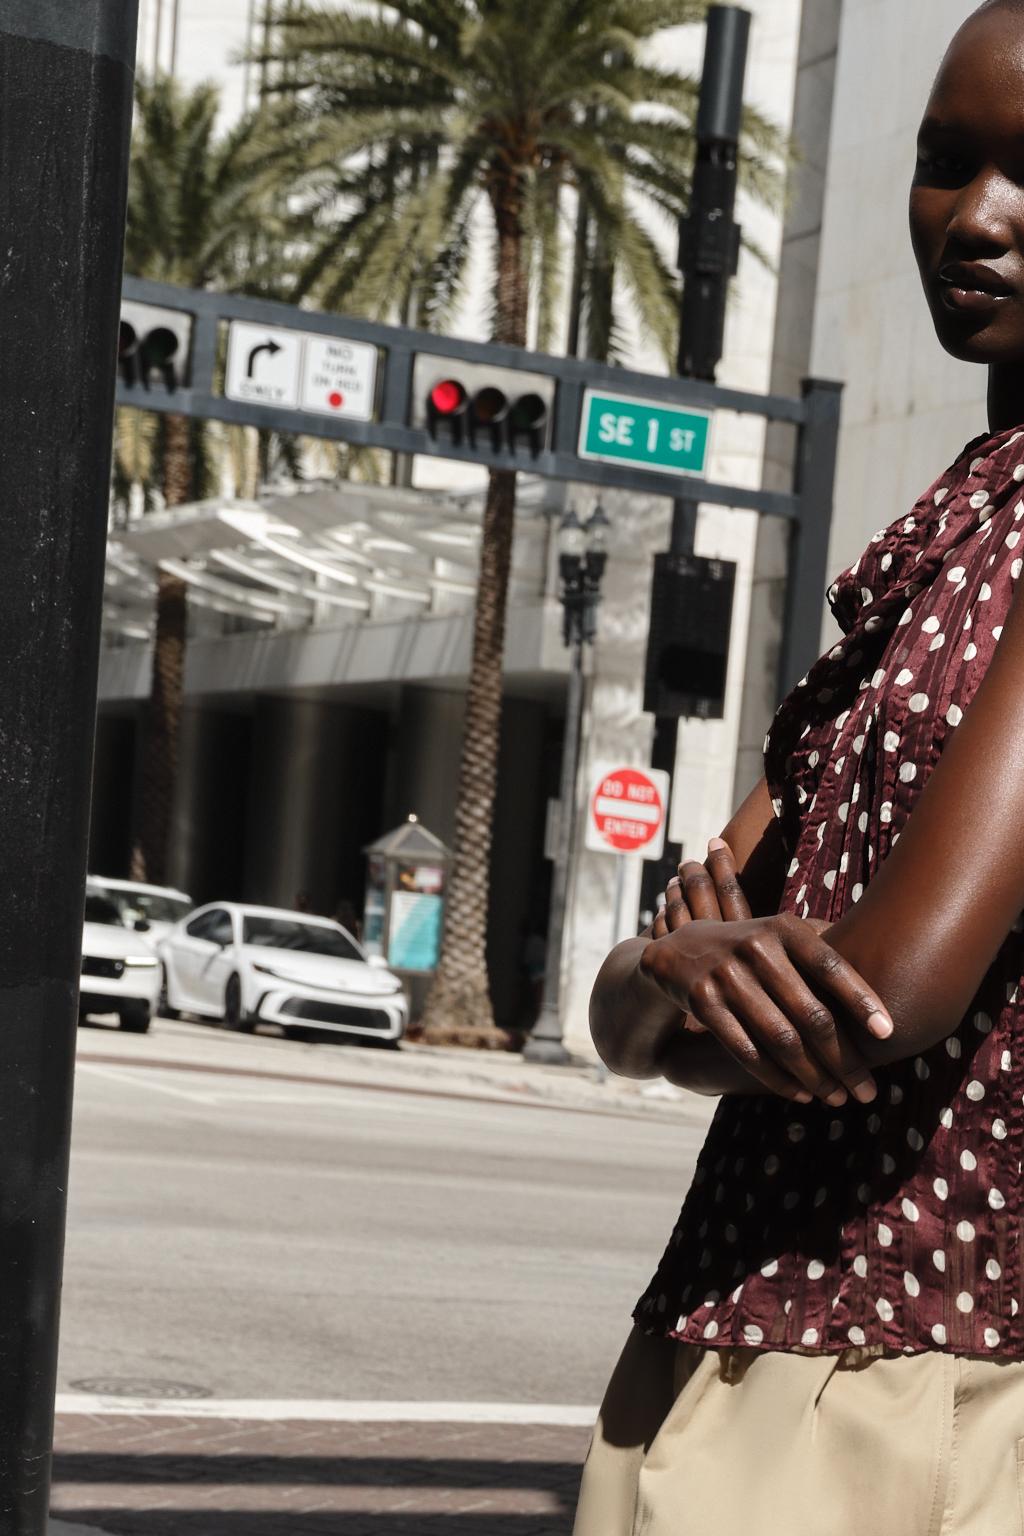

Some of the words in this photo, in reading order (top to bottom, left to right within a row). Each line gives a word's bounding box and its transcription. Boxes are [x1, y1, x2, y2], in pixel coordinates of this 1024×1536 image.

[598, 413, 635, 447] SE
[646, 418, 660, 453] 1
[669, 428, 696, 453] ST
[602, 779, 624, 798] DO
[627, 783, 656, 802] NOT
[603, 817, 648, 840] ENTER
